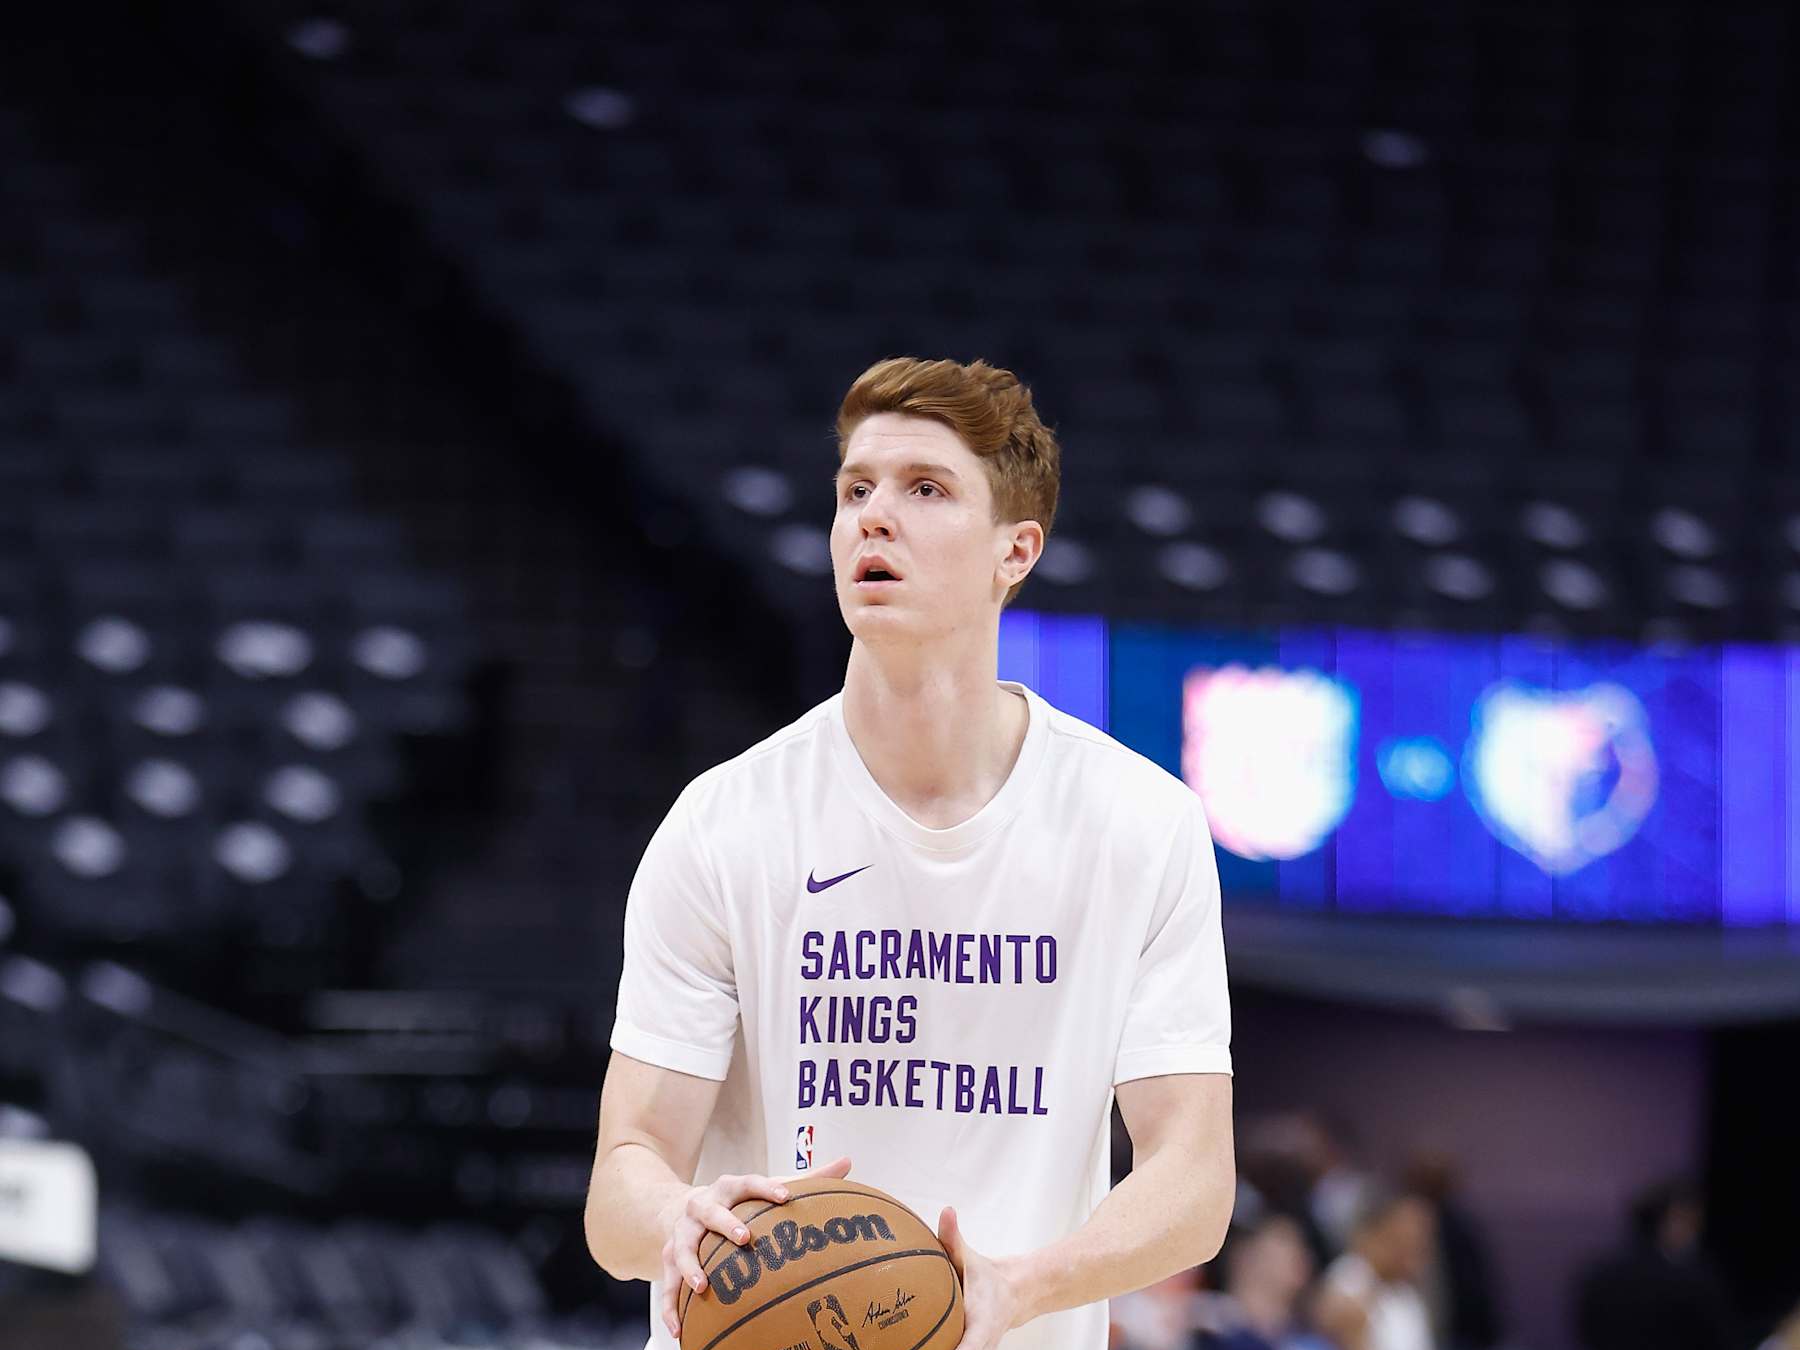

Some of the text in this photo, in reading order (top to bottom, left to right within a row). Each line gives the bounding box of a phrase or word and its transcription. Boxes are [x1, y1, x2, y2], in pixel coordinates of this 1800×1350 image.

[800, 929, 1057, 985] SACRAMENTO
[799, 995, 918, 1044] KINGS
[798, 1058, 1049, 1116] BASKETBALL
[708, 1213, 897, 1306] Wilson
